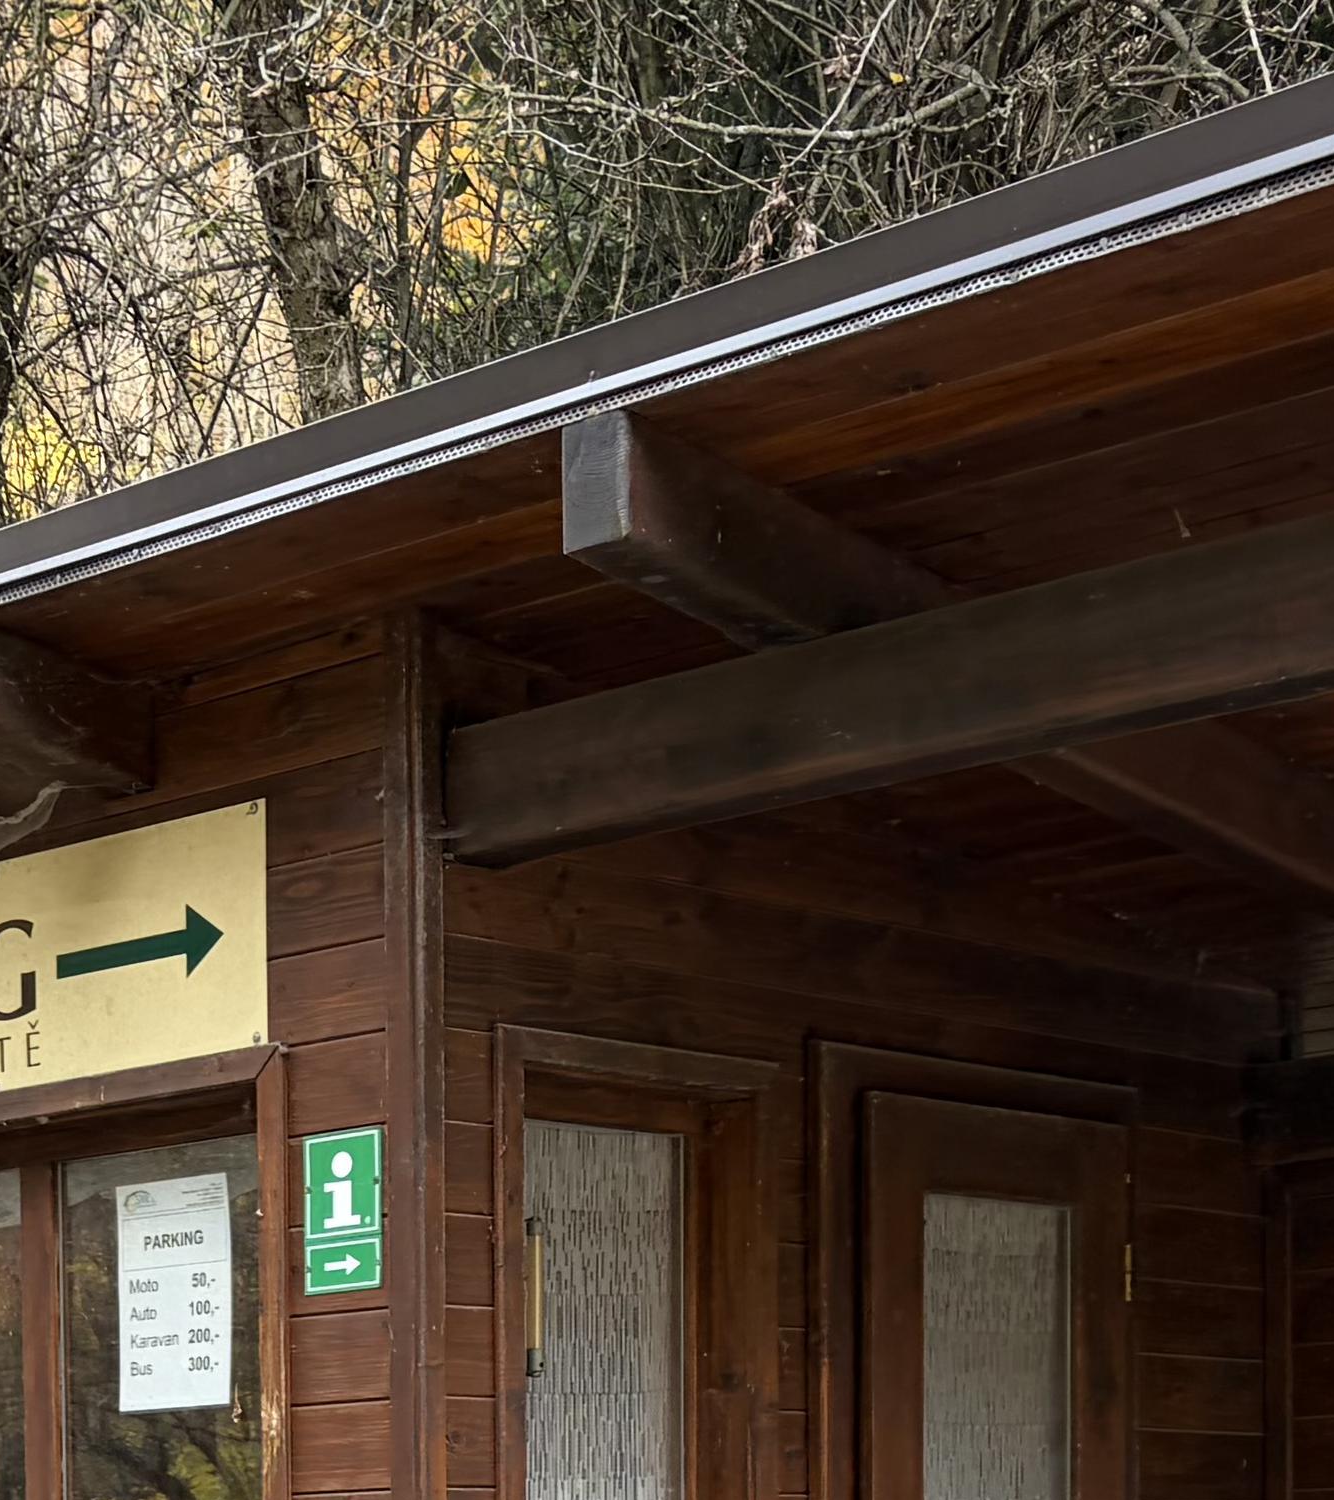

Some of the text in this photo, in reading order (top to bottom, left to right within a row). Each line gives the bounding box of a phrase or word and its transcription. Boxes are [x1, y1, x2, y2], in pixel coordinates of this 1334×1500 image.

[143, 1230, 204, 1251] PARKING
[129, 1272, 216, 1294] Moto 50,-
[130, 1300, 220, 1321] Auto 100,-
[130, 1329, 220, 1349] Karavan 200,-
[130, 1357, 219, 1376] Bus 300,-
